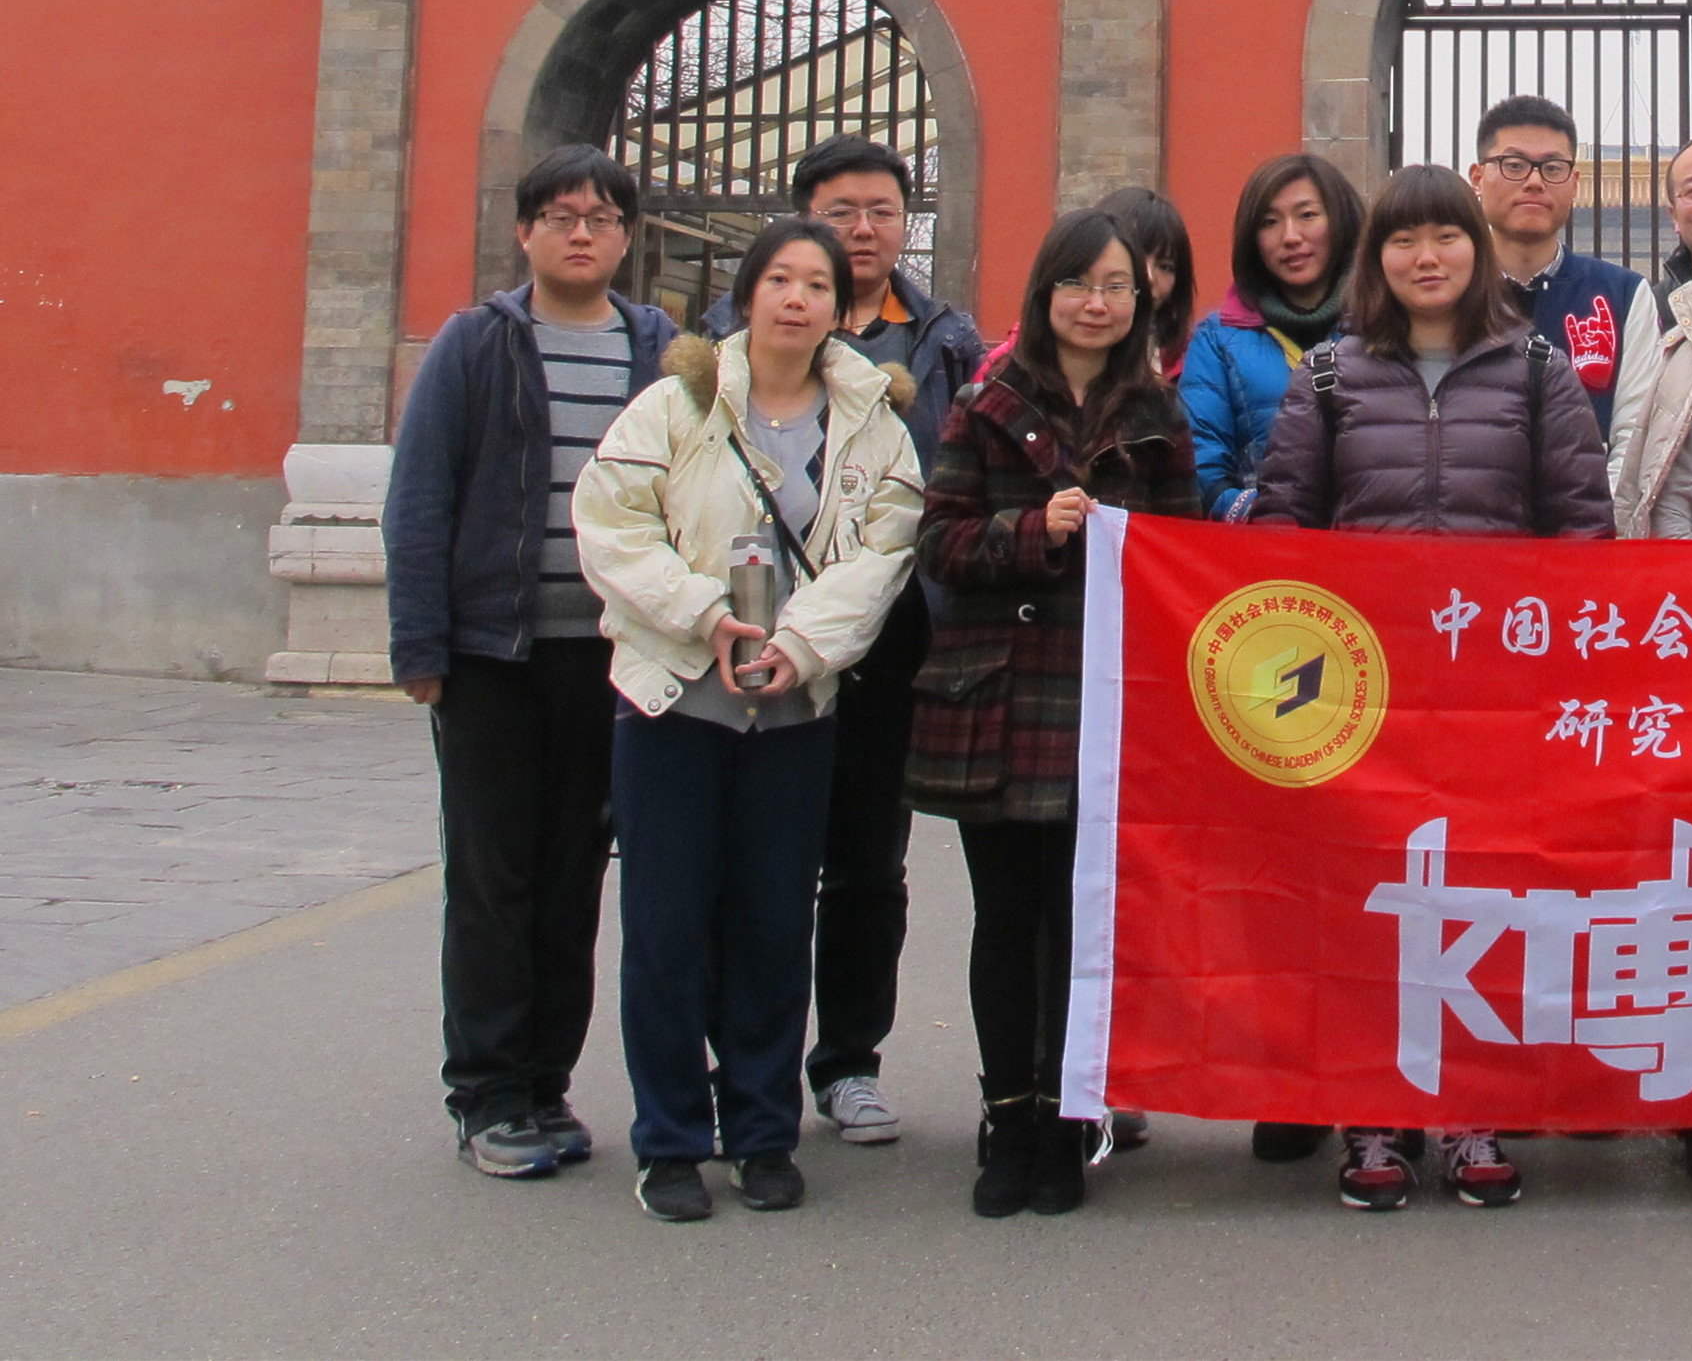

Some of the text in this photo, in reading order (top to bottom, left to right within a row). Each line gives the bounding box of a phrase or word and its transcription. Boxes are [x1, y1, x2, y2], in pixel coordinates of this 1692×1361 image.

[1574, 350, 1609, 364] adidas
[1207, 596, 1369, 668] 中国社会科学院研究生院
[1217, 712, 1242, 744] SCHOOL
[1240, 739, 1252, 751] OF
[1250, 747, 1284, 769] CHINESE
[1284, 749, 1324, 769] ACADEMY
[1322, 742, 1335, 757] OF
[1332, 721, 1359, 749] SOCIAL
[1350, 680, 1368, 721] SCIENCES
